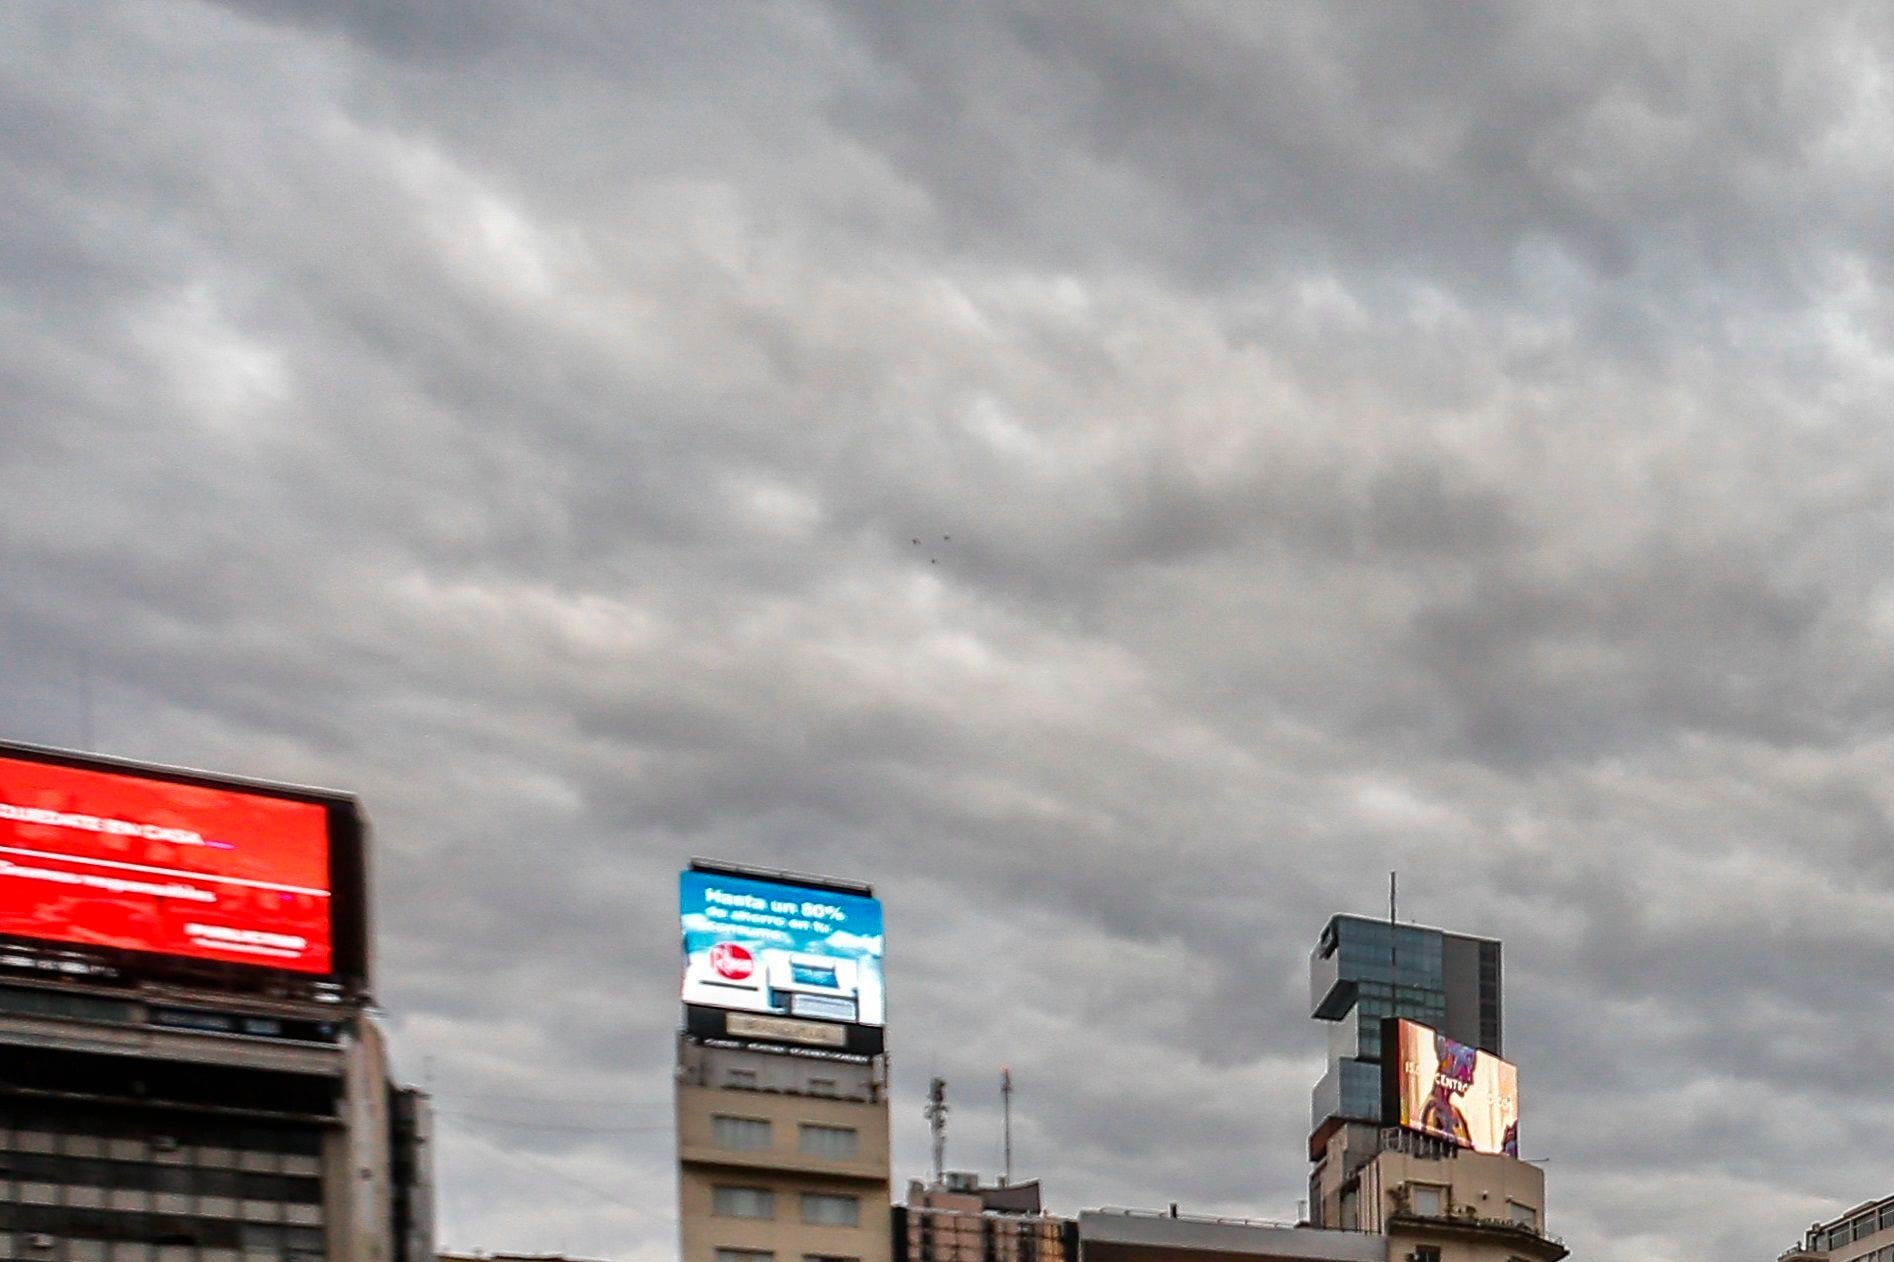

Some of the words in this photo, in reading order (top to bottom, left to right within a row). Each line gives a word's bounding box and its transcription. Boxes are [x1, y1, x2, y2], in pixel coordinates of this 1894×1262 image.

[705, 888, 767, 910] Hasta
[771, 900, 798, 915] un
[788, 919, 811, 930] en
